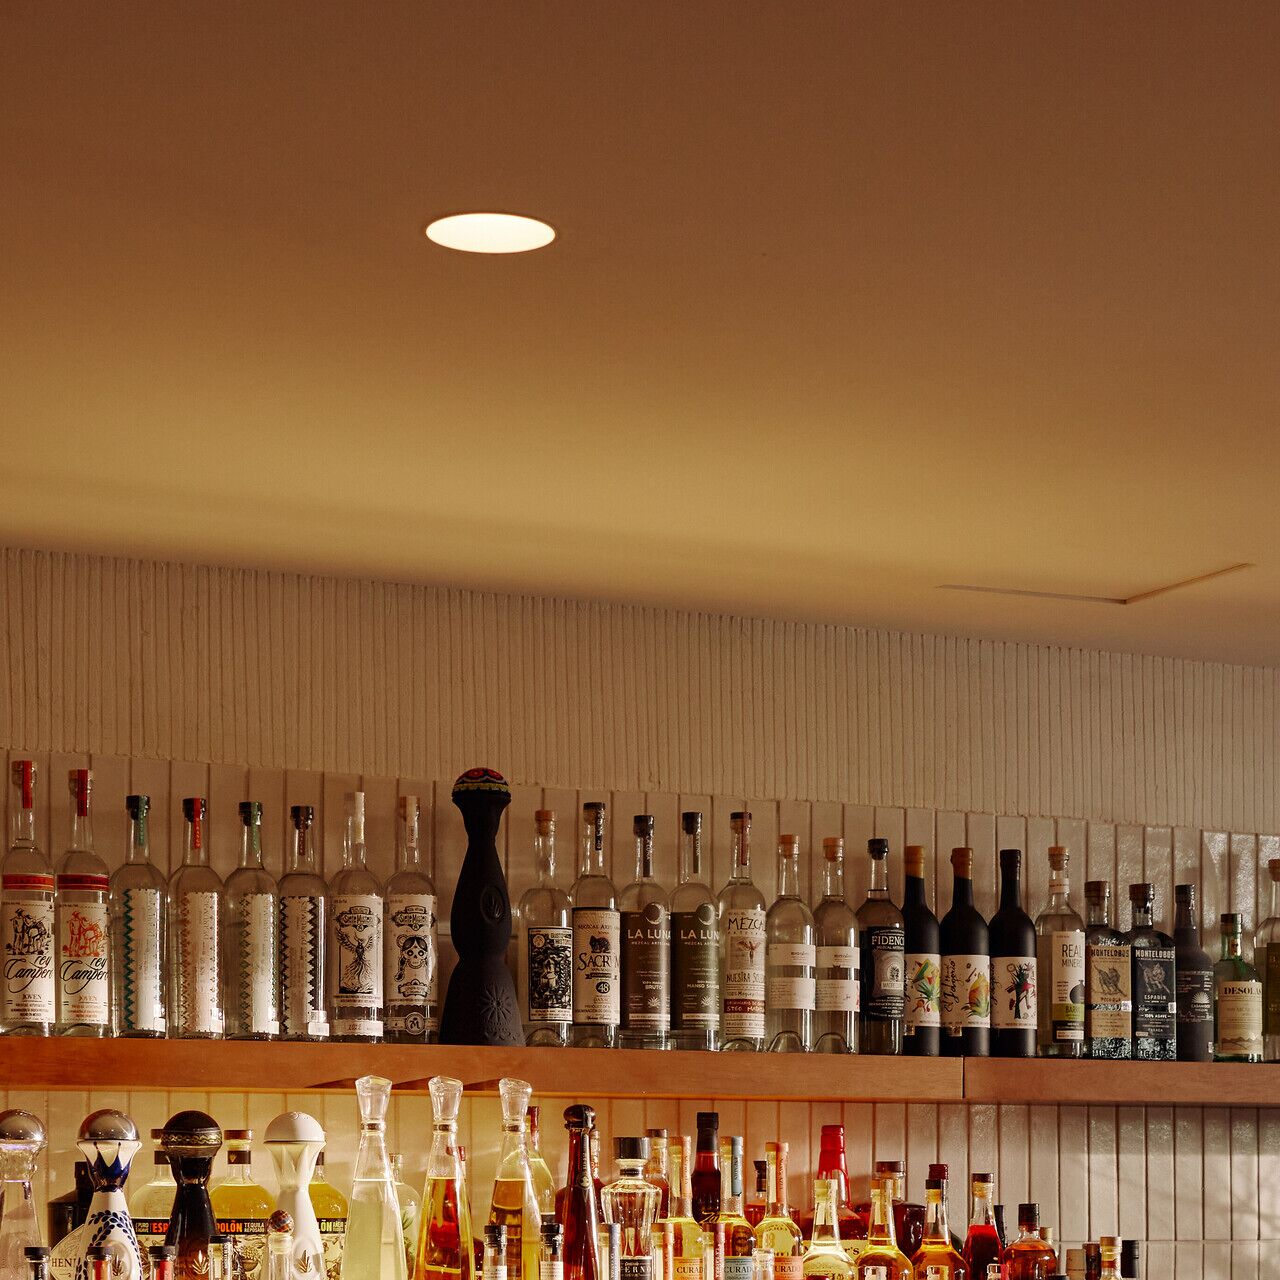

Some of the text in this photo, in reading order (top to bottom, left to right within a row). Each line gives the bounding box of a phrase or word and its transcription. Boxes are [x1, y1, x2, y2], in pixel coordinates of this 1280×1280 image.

[627, 929, 641, 939] LA
[680, 930, 696, 940] LA
[1091, 948, 1129, 957] MONTELOBOS
[1135, 949, 1175, 959] MONTELOBOS
